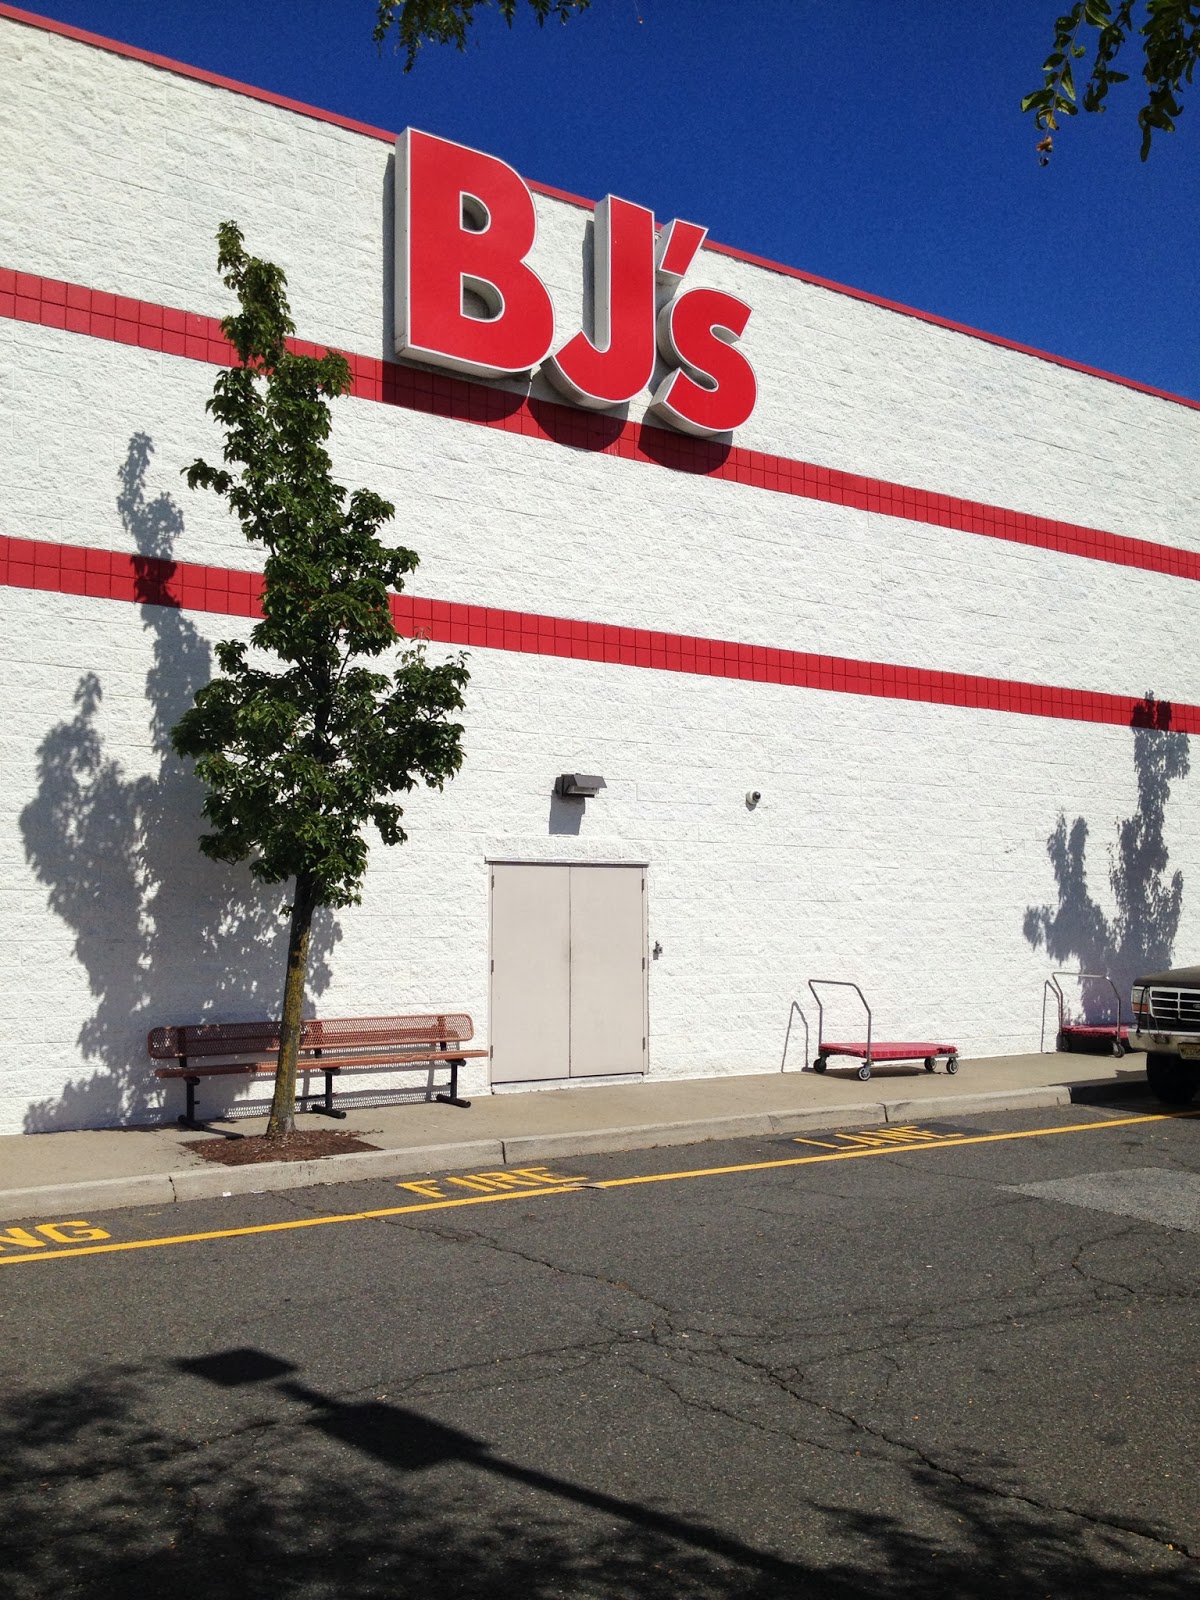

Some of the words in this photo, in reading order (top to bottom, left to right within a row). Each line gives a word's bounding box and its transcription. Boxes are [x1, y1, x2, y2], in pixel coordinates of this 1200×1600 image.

[395, 127, 758, 436] BJ's
[396, 1166, 589, 1198] FIRE
[792, 1125, 965, 1150] LANE
